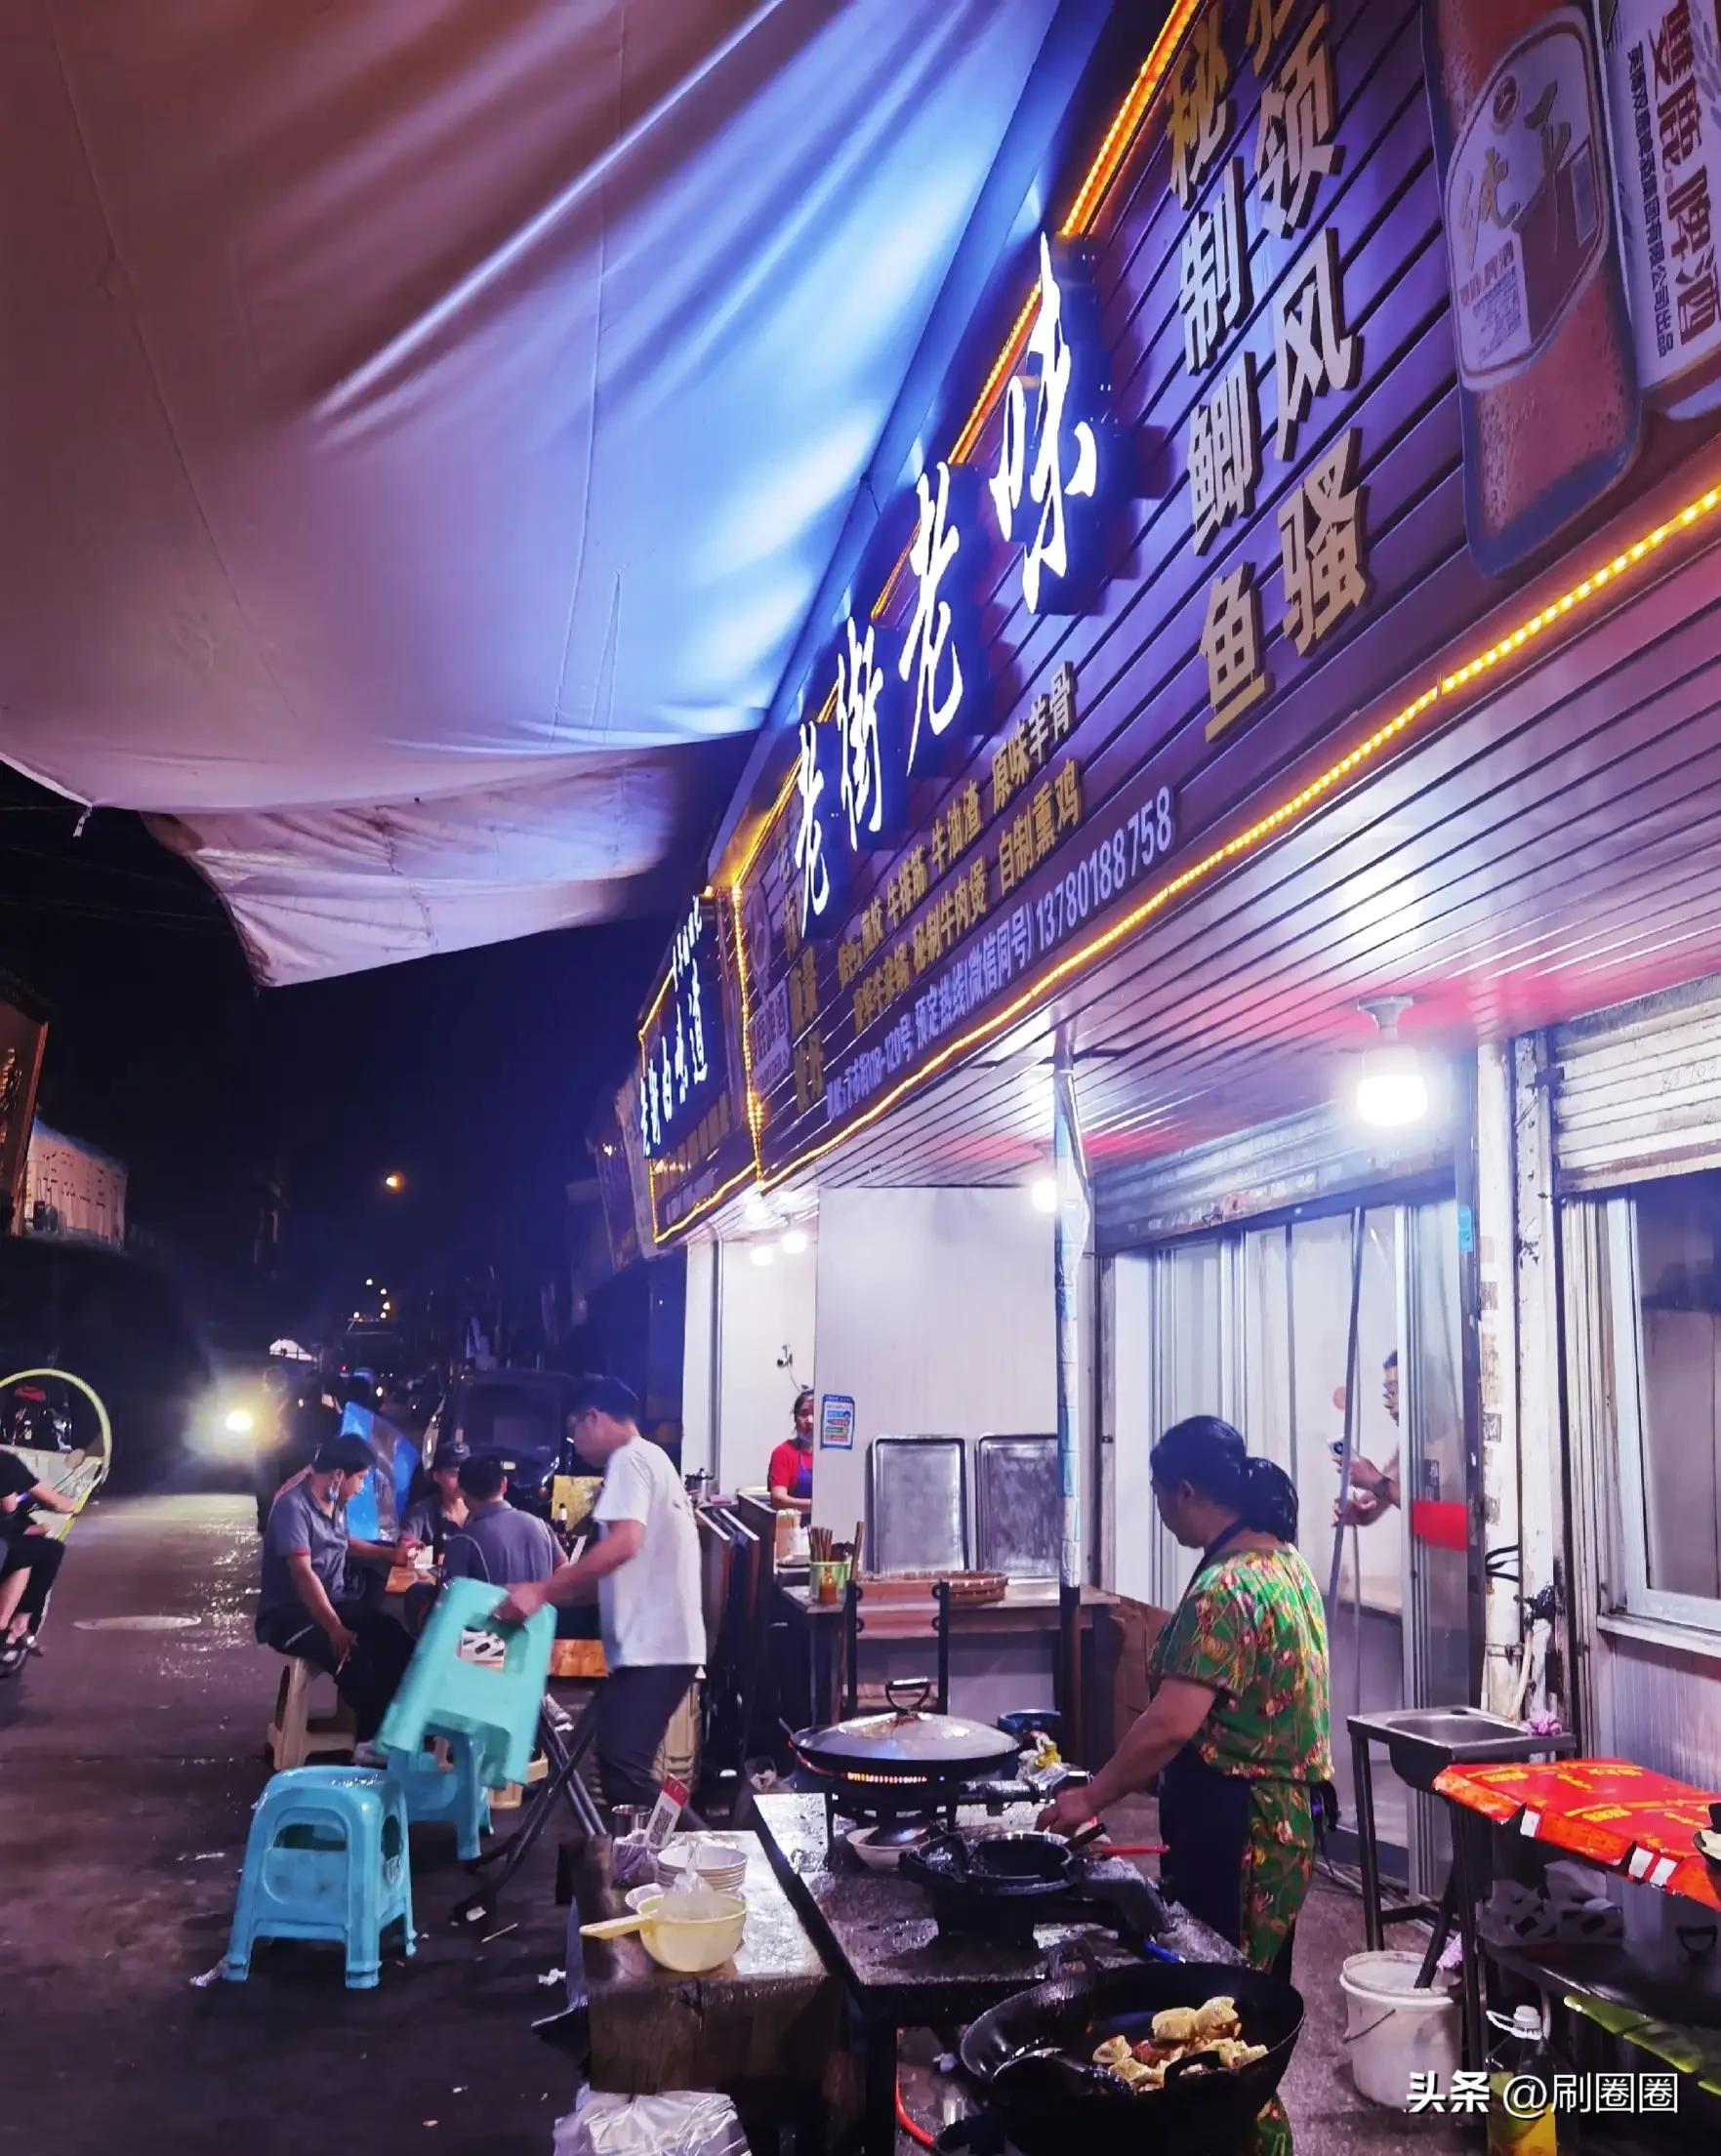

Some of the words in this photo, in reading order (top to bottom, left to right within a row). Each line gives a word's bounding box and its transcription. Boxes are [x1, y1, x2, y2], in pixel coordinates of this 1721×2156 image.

[1168, 0, 1269, 742] 秘制鲫鱼
[1036, 785, 1172, 951] 13780188758
